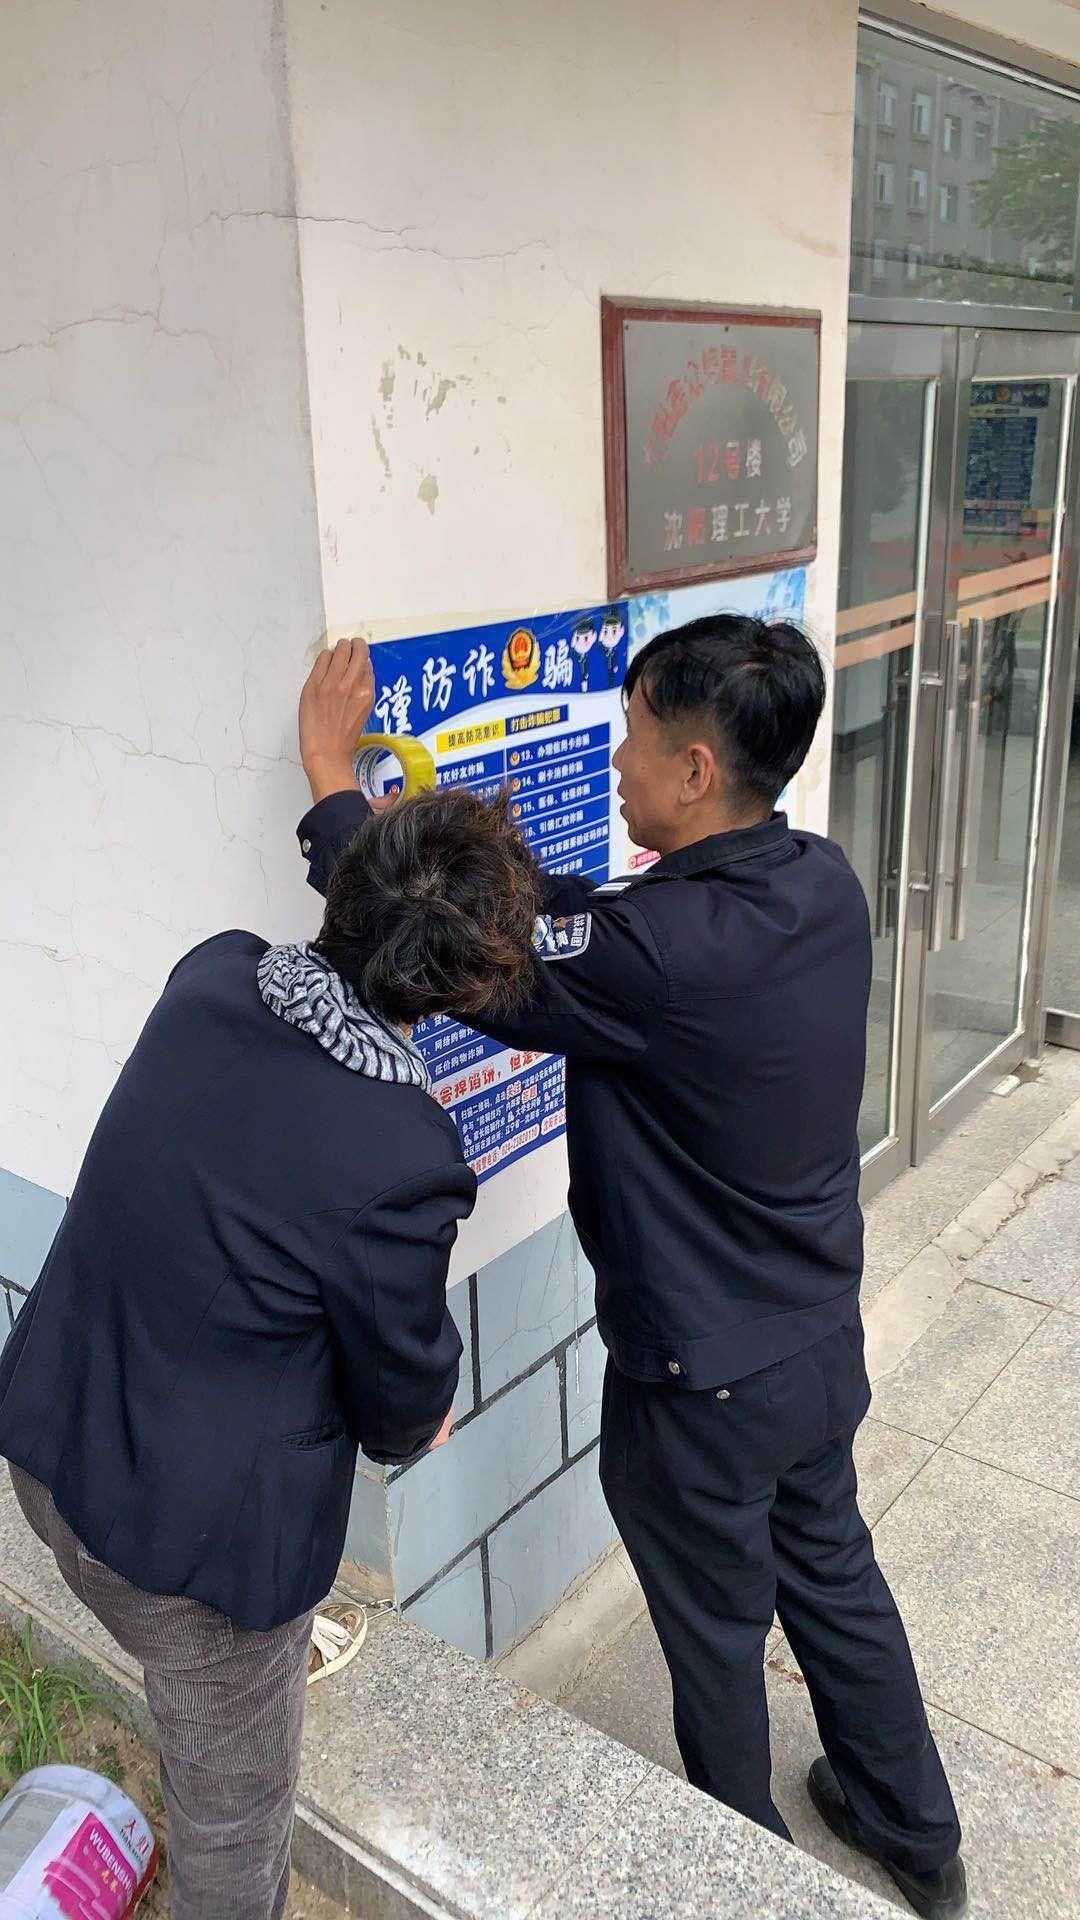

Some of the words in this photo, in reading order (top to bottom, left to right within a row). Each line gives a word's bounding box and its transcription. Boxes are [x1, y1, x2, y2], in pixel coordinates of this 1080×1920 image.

[664, 497, 792, 550] 沈阳理工大学
[374, 638, 574, 736] 谨防诈骗
[447, 721, 500, 748] 提高防范意识
[435, 1044, 484, 1076] 低价购物诈骗
